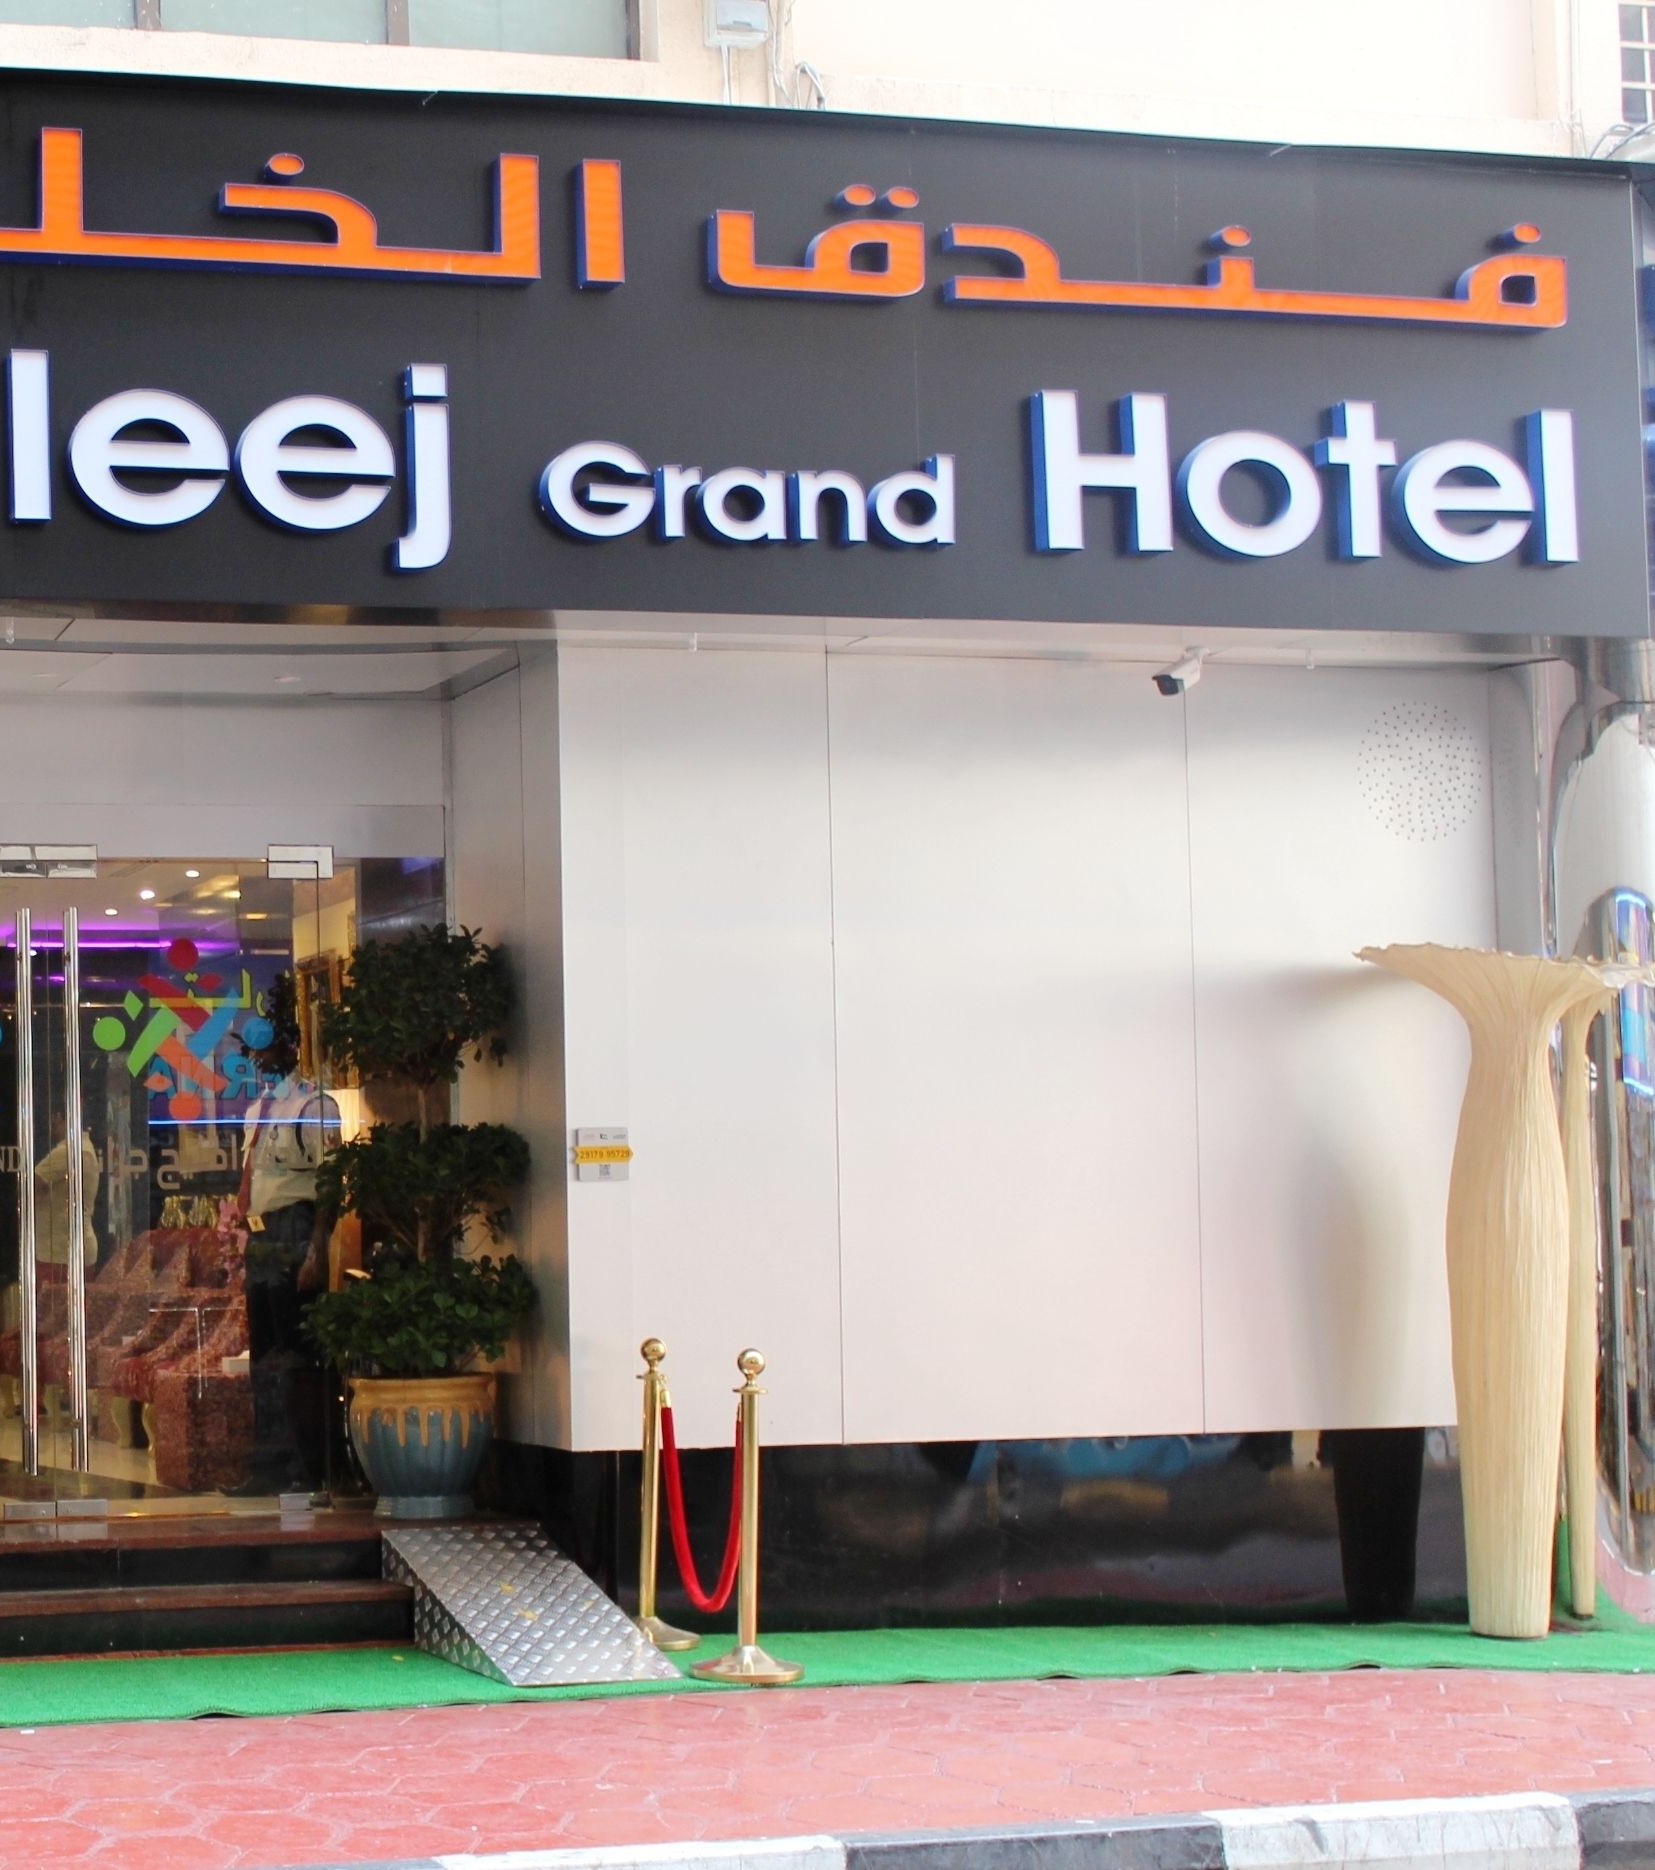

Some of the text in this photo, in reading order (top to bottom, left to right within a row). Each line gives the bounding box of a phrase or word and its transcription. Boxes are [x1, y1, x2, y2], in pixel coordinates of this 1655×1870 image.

[710, 184, 1570, 329] فندق
[542, 440, 957, 546] Grand
[1034, 388, 1581, 564] Hotel
